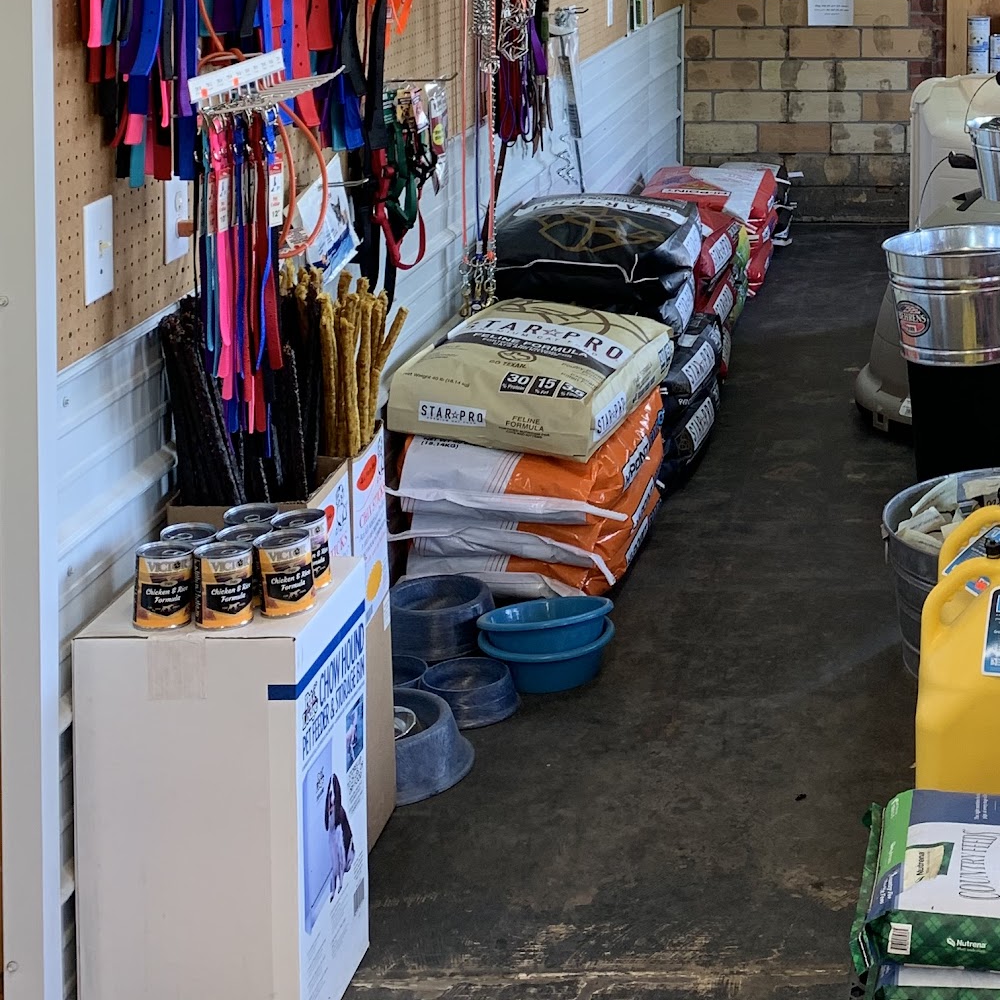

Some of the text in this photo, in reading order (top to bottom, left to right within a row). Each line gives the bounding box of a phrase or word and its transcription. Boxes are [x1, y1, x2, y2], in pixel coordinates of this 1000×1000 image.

[472, 331, 590, 359] FELINE FORMULA
[562, 331, 624, 361] PRO
[507, 373, 555, 390] 30 15
[421, 405, 484, 423] STAR PRO
[505, 415, 545, 433] FELINE FORMULA
[271, 569, 311, 586] Chicken Rice
[145, 584, 189, 597] Chicken Rice
[211, 586, 236, 597] Chicken
[281, 581, 306, 592] Formula
[154, 594, 182, 605] Formula
[221, 592, 247, 604] Formula
[320, 622, 365, 708] CHOW HOUND
[302, 654, 365, 761] PET FEEDER & STORAGE BIN
[916, 852, 925, 876] Nutrena
[958, 852, 1000, 900] COUNTRY
[957, 939, 987, 949] Nutrena
